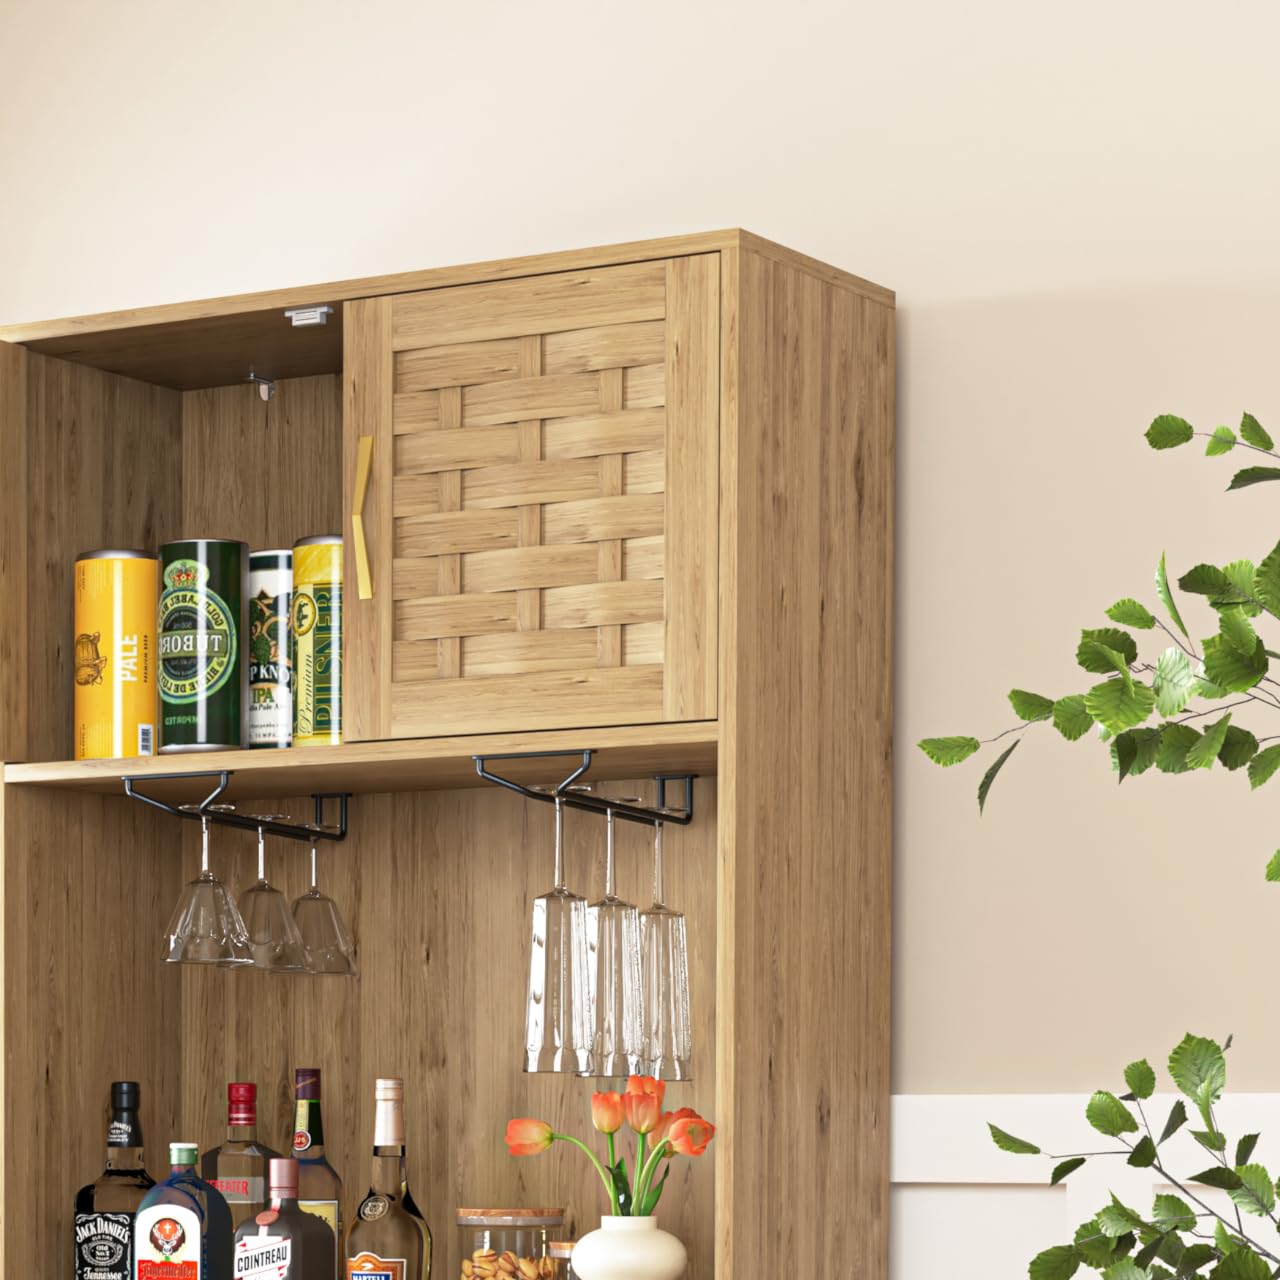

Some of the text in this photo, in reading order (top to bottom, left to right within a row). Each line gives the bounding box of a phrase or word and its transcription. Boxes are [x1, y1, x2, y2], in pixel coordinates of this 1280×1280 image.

[120, 633, 138, 682] PALE
[252, 688, 274, 704] IPA
[299, 654, 312, 734] Premium
[76, 1221, 97, 1243] JACK
[237, 1245, 288, 1273] COINTREAU
[83, 1267, 122, 1280] Tennessee
